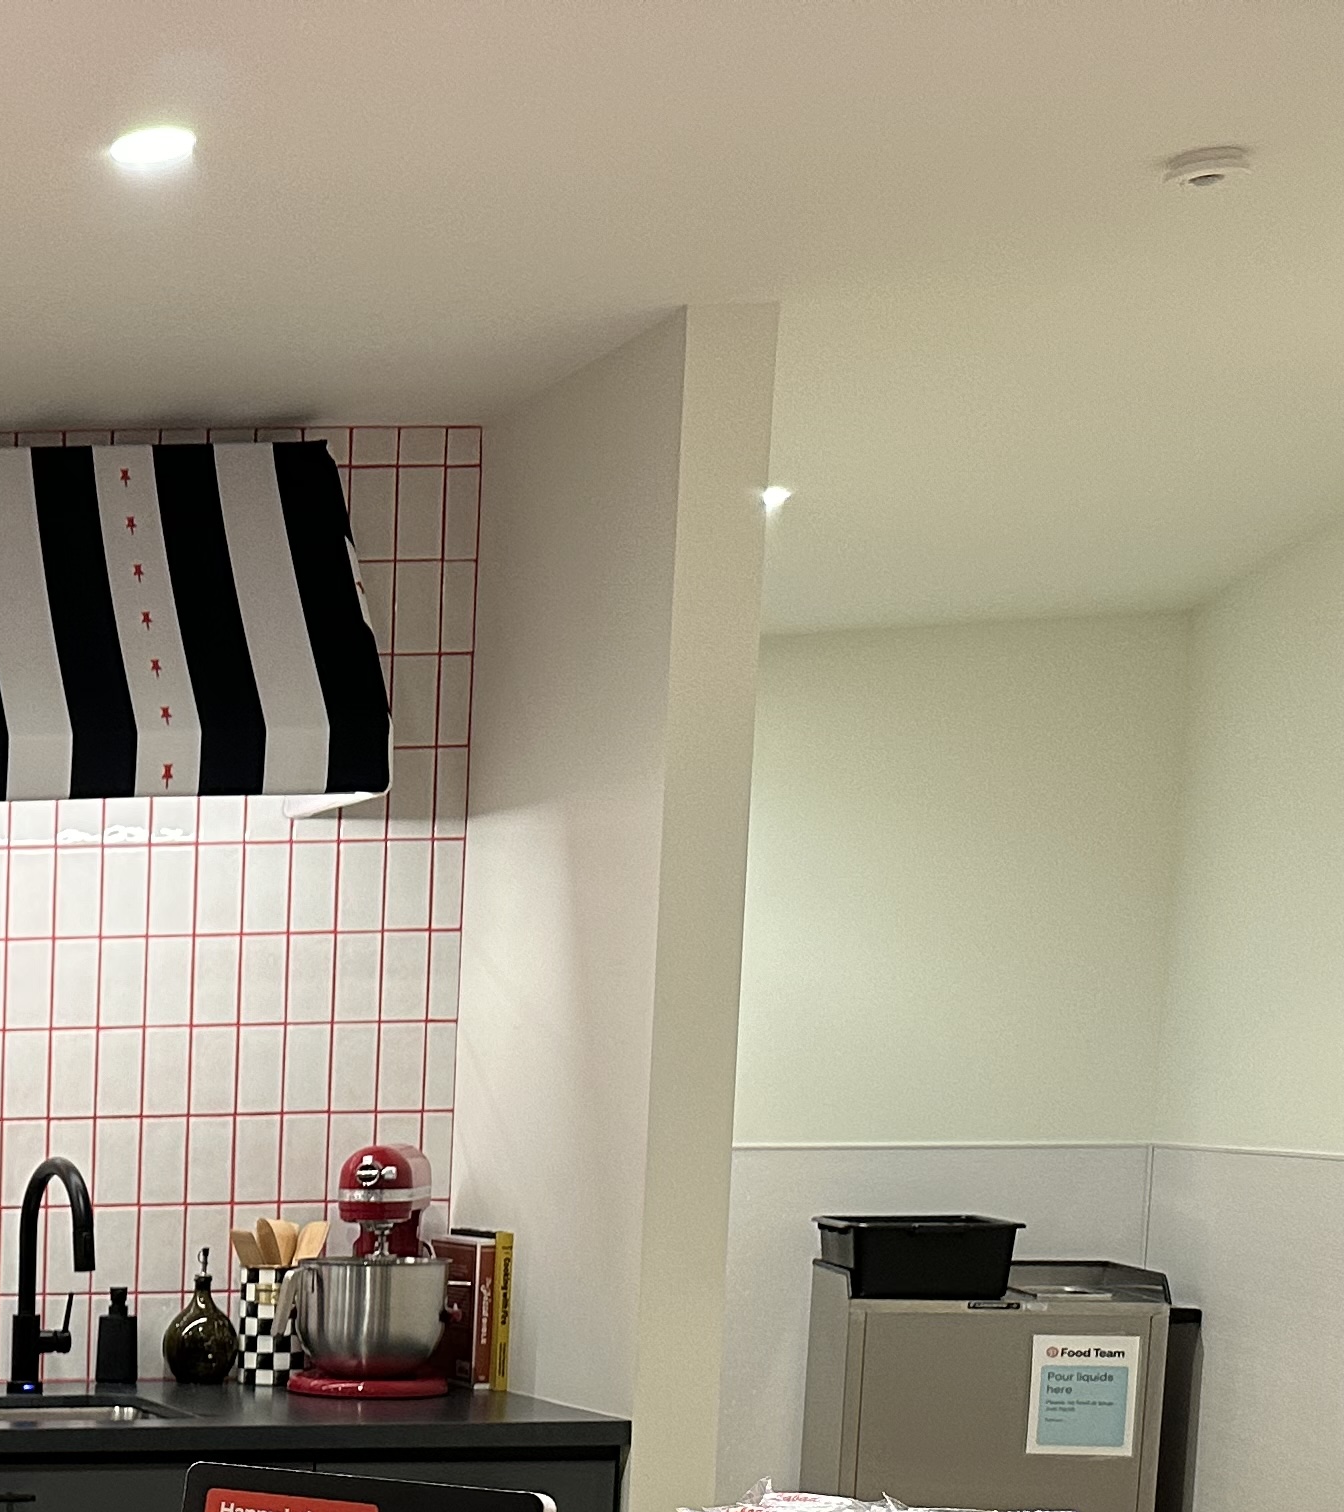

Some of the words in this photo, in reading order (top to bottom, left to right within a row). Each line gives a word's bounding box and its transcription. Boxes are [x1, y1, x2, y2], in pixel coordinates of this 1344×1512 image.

[1060, 1347, 1091, 1358] Food
[1094, 1347, 1125, 1358] Team
[1047, 1371, 1074, 1382] Pour
[1076, 1371, 1114, 1383] liquids
[1046, 1384, 1073, 1395] here
